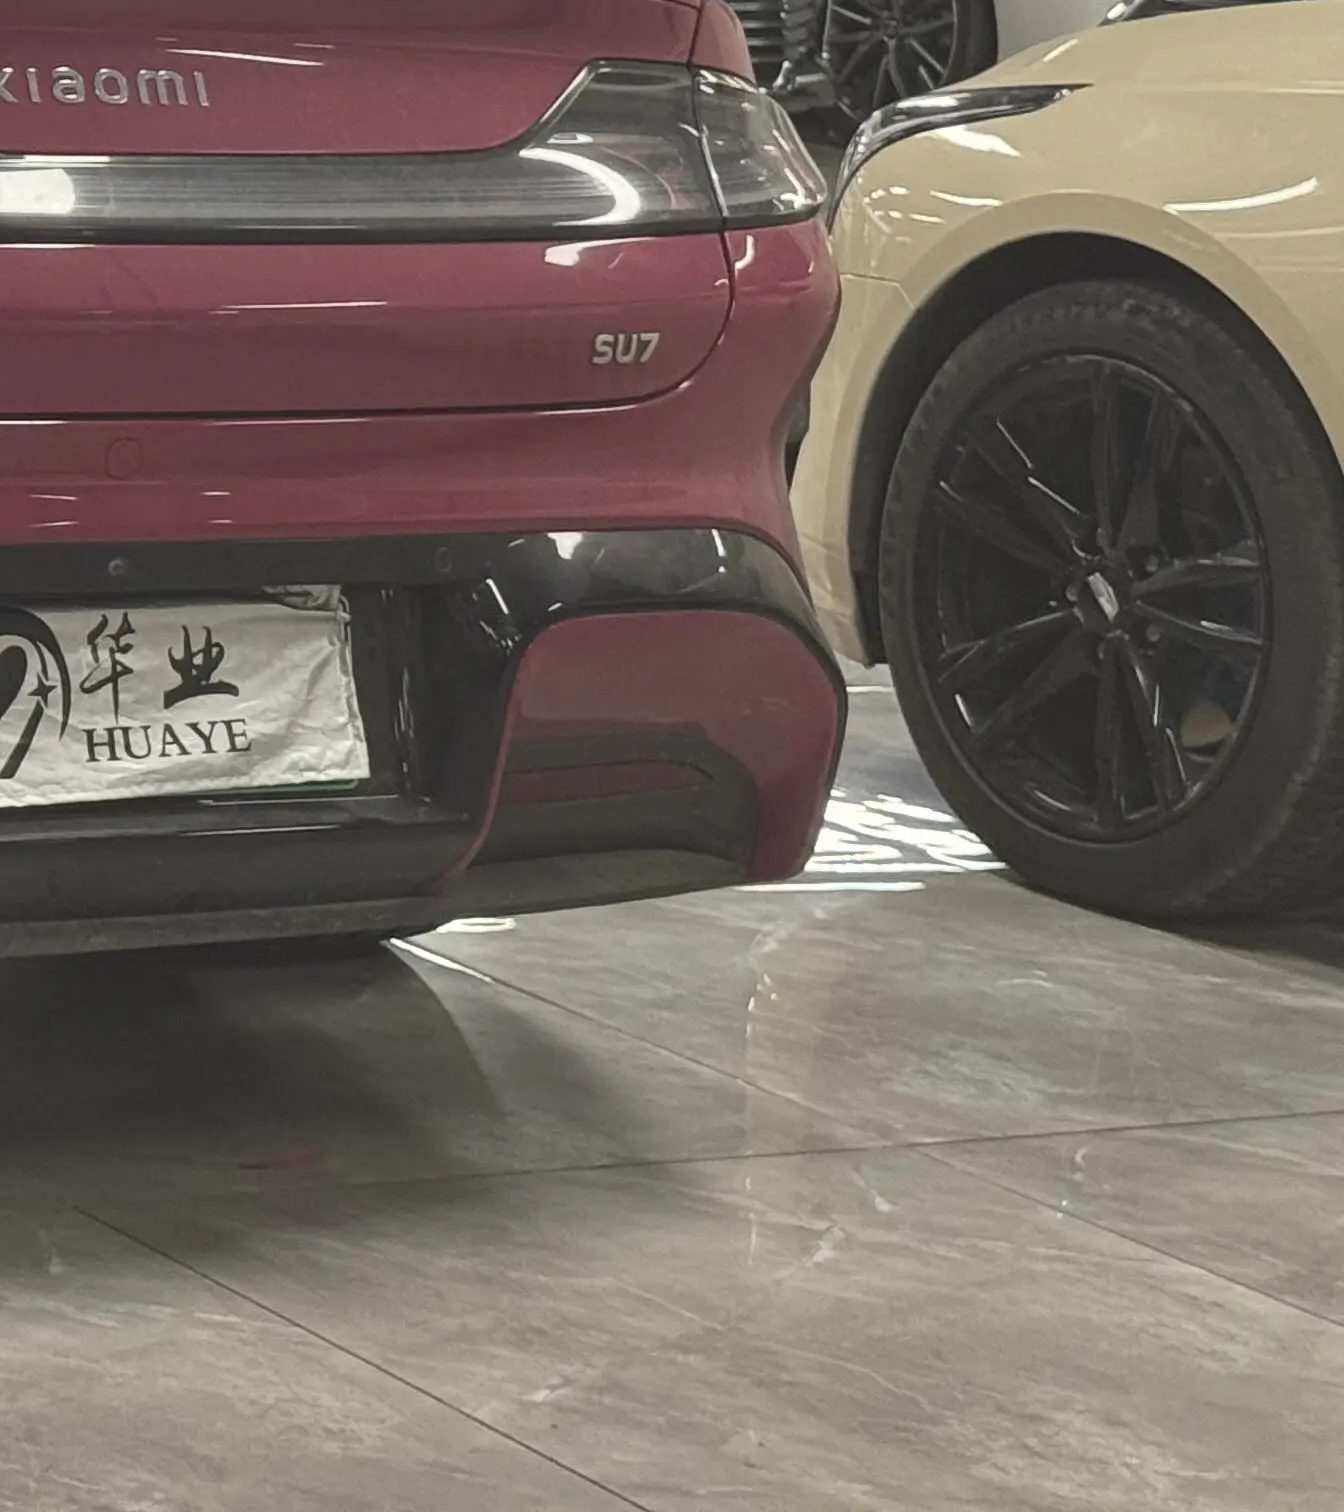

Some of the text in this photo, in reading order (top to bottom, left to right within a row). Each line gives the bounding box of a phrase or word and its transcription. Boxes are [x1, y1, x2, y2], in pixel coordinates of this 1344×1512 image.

[591, 332, 661, 365] SU7
[78, 610, 241, 726] 华业
[81, 718, 253, 764] HUAYE
